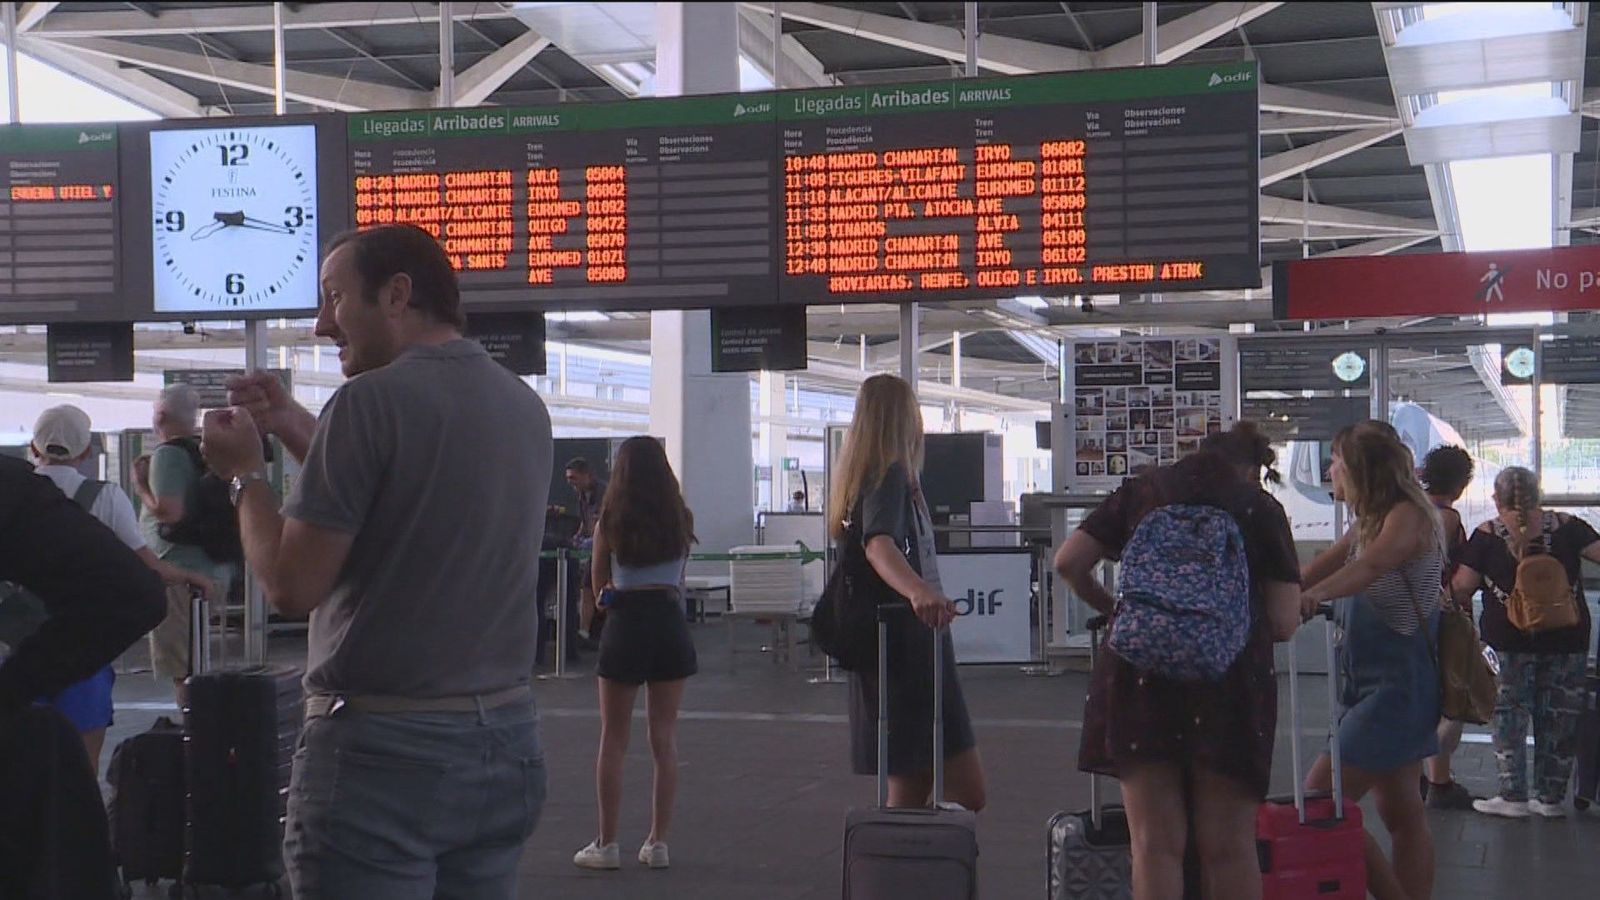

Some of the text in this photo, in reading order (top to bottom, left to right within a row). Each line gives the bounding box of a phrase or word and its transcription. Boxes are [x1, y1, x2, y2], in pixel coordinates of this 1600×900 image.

[1223, 72, 1251, 83] adif
[795, 88, 1011, 114] Llegadas Arribades ARRIVALS
[1124, 106, 1186, 117] Observaciones
[363, 114, 560, 136] Llegadas Arribades ARRIVALS
[976, 128, 993, 136] Tren
[1124, 116, 1181, 127] Observacions
[217, 144, 249, 166] 12
[785, 156, 826, 171] 10:40
[829, 153, 876, 168] MADRID
[976, 145, 1010, 161] IRYO
[395, 174, 439, 189] MADRID
[527, 169, 558, 183] AVLO
[786, 173, 826, 188] 11:09
[829, 165, 966, 185] FIGUERES-VILAFANT
[976, 162, 1035, 178] EUROMED
[211, 187, 256, 198] FESTINA
[395, 190, 440, 205] MADRID
[528, 186, 558, 200] IRYO
[829, 183, 957, 202] ALACANT/ALICANTE
[976, 180, 1035, 196] EUROMED
[166, 210, 185, 233] 9
[284, 206, 303, 229] 3
[396, 204, 512, 222] ALACANT/ALICANTE
[528, 201, 580, 216] EUROMED
[786, 207, 826, 222] 11:35
[829, 204, 877, 219] MADRID
[885, 203, 914, 217] PTA.
[924, 200, 973, 216] ATOCHA
[978, 199, 1002, 213] AVE
[977, 215, 1019, 231] ALVIA
[1041, 212, 1085, 229] 04111
[528, 218, 566, 233] OUIGO
[528, 235, 551, 250] AVE
[786, 241, 827, 256] 12:30
[829, 239, 878, 254] MADRID
[978, 233, 1002, 248] AVE
[1042, 230, 1086, 246] 05100
[468, 254, 506, 268] SANTS
[528, 251, 581, 267] EUROMED
[786, 258, 827, 273] 12:40
[829, 256, 878, 271] MADRID
[977, 250, 1011, 266] IRYO
[226, 273, 245, 295] 6
[528, 268, 552, 283] AVE
[921, 273, 969, 289] RENFE,
[978, 269, 1019, 286] OUIGO
[1026, 268, 1036, 284] E
[1043, 267, 1083, 283] IRYO.
[1093, 264, 1154, 282] PRESTEN
[1536, 270, 1569, 289] No
[951, 588, 1004, 616] dif
